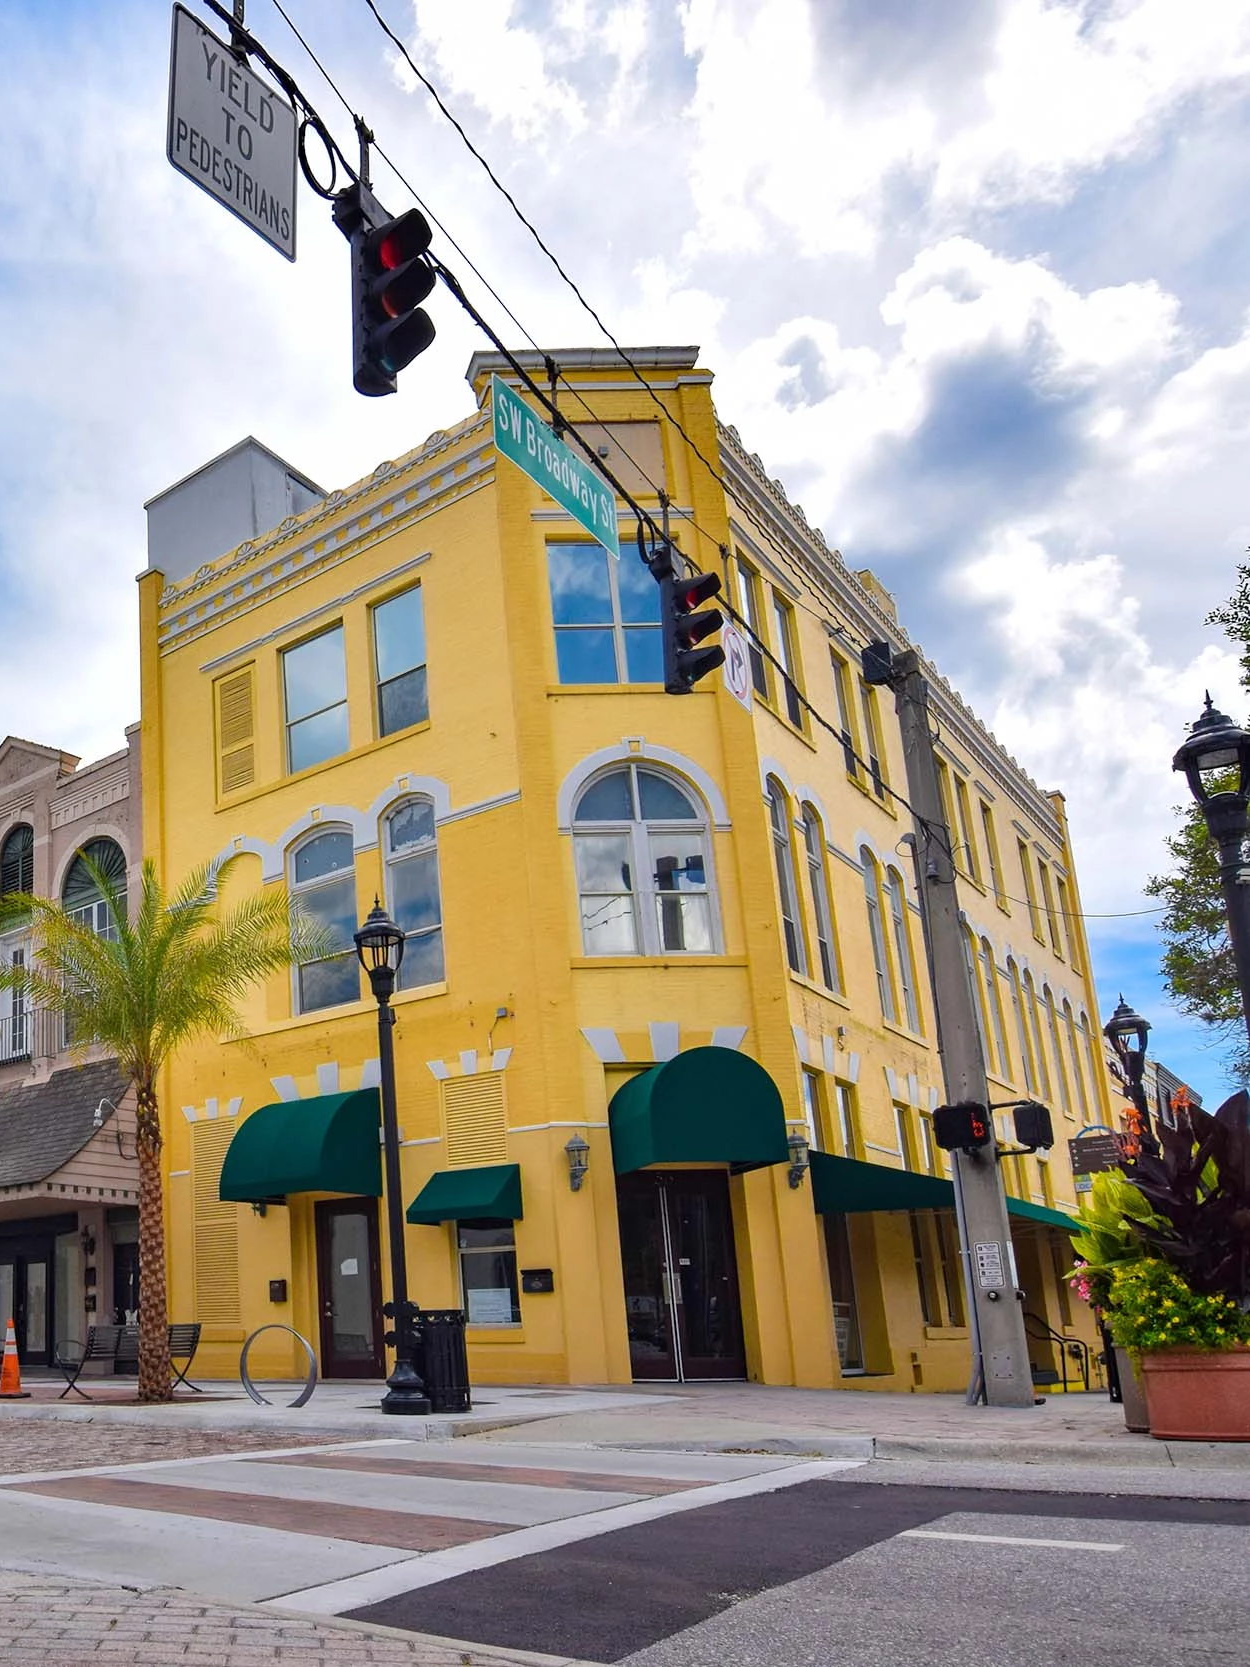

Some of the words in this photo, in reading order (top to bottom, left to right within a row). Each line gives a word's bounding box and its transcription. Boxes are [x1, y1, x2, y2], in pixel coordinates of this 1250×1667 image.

[201, 41, 274, 134] YIELD
[222, 106, 253, 161] TO
[176, 117, 291, 242] PEDESTRIANS
[498, 393, 522, 444] SW
[526, 417, 598, 526] Broadway
[600, 494, 614, 535] St
